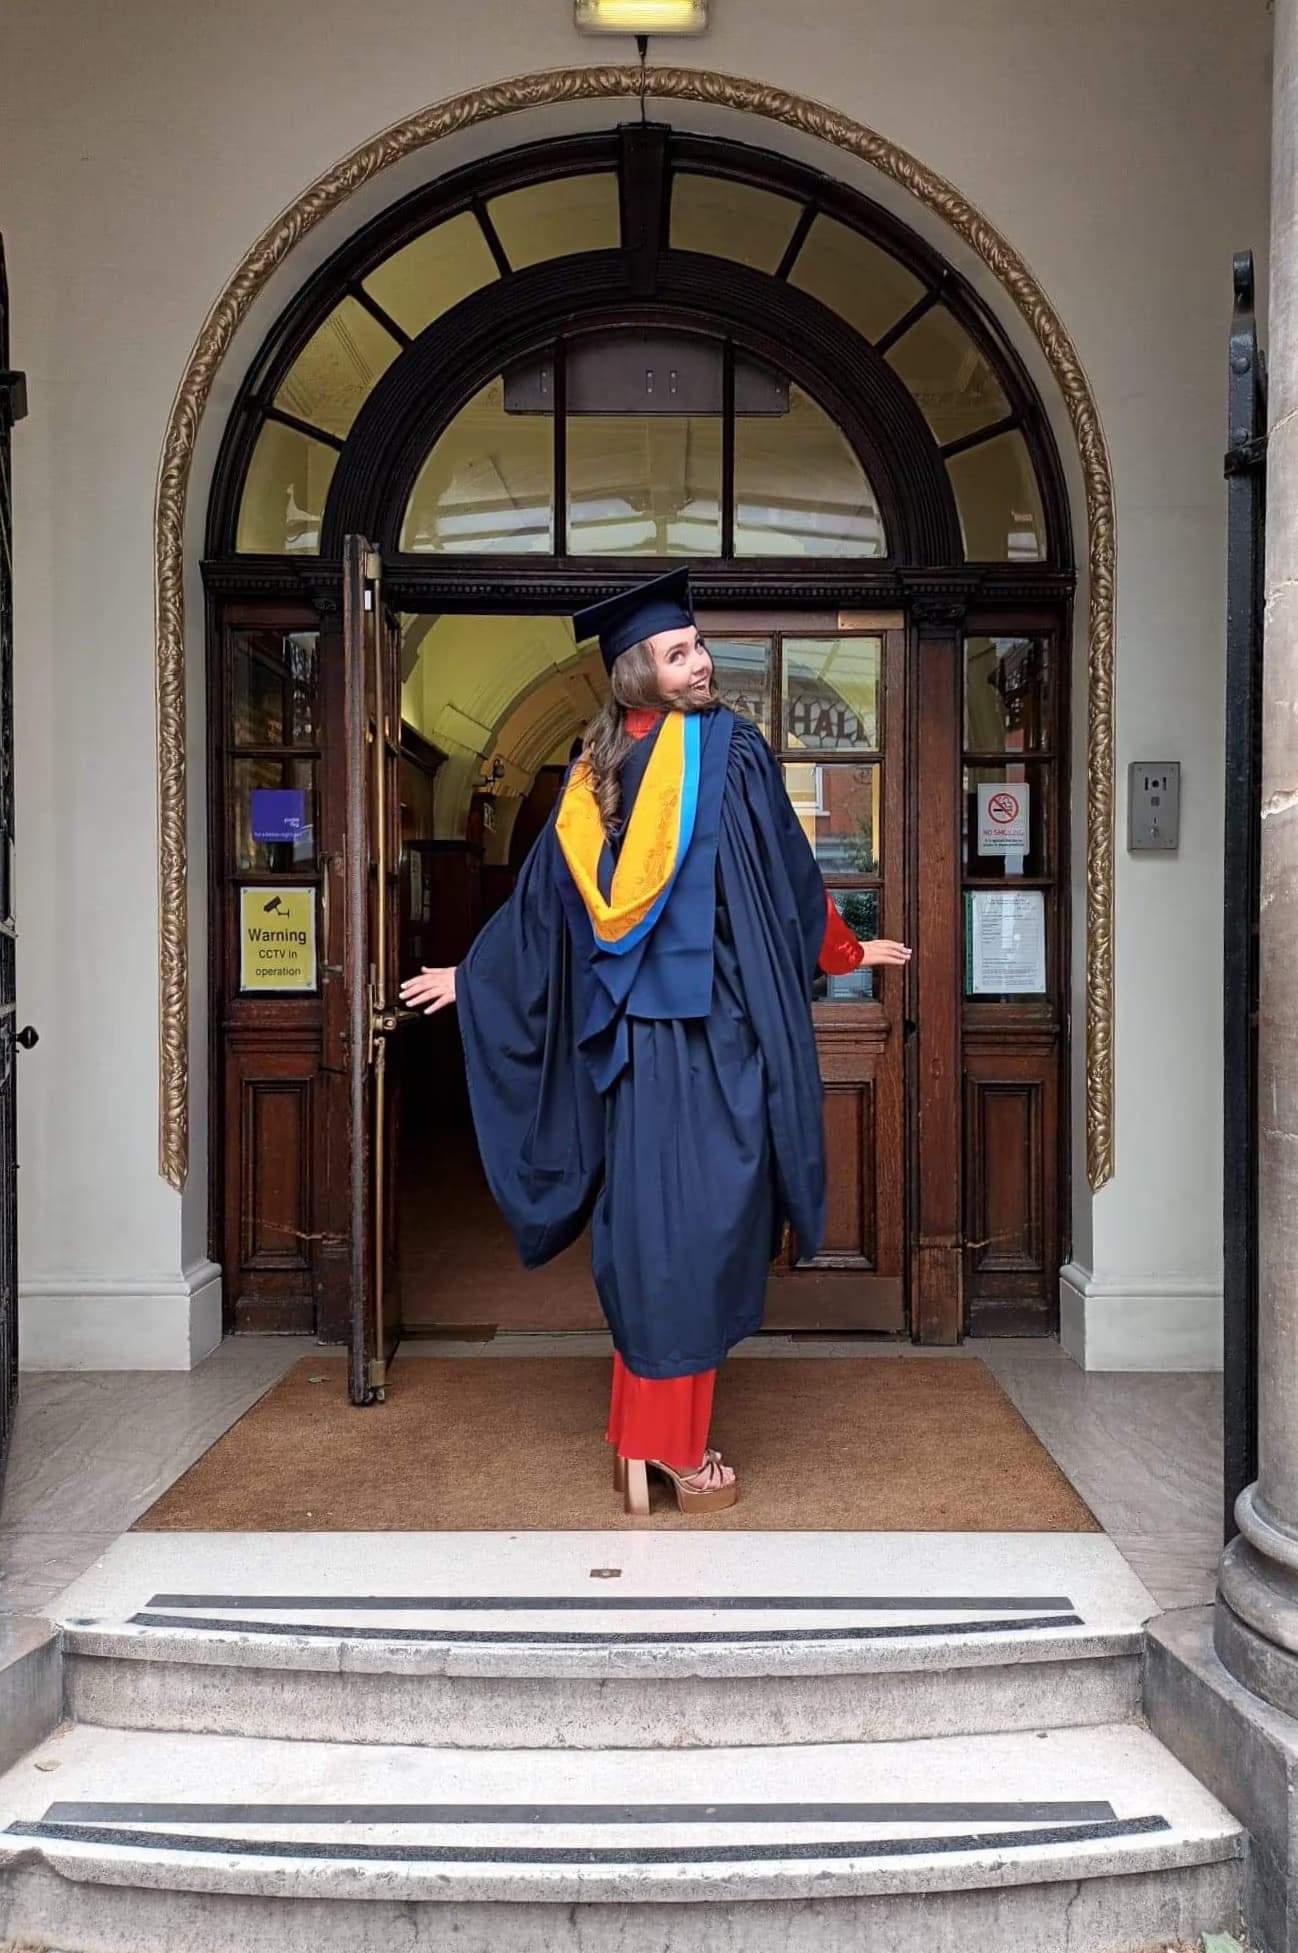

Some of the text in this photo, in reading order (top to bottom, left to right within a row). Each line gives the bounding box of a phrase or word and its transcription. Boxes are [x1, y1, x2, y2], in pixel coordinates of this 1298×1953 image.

[248, 928, 307, 945] Warning
[259, 949, 298, 959] CCTV in
[255, 967, 301, 978] operation
